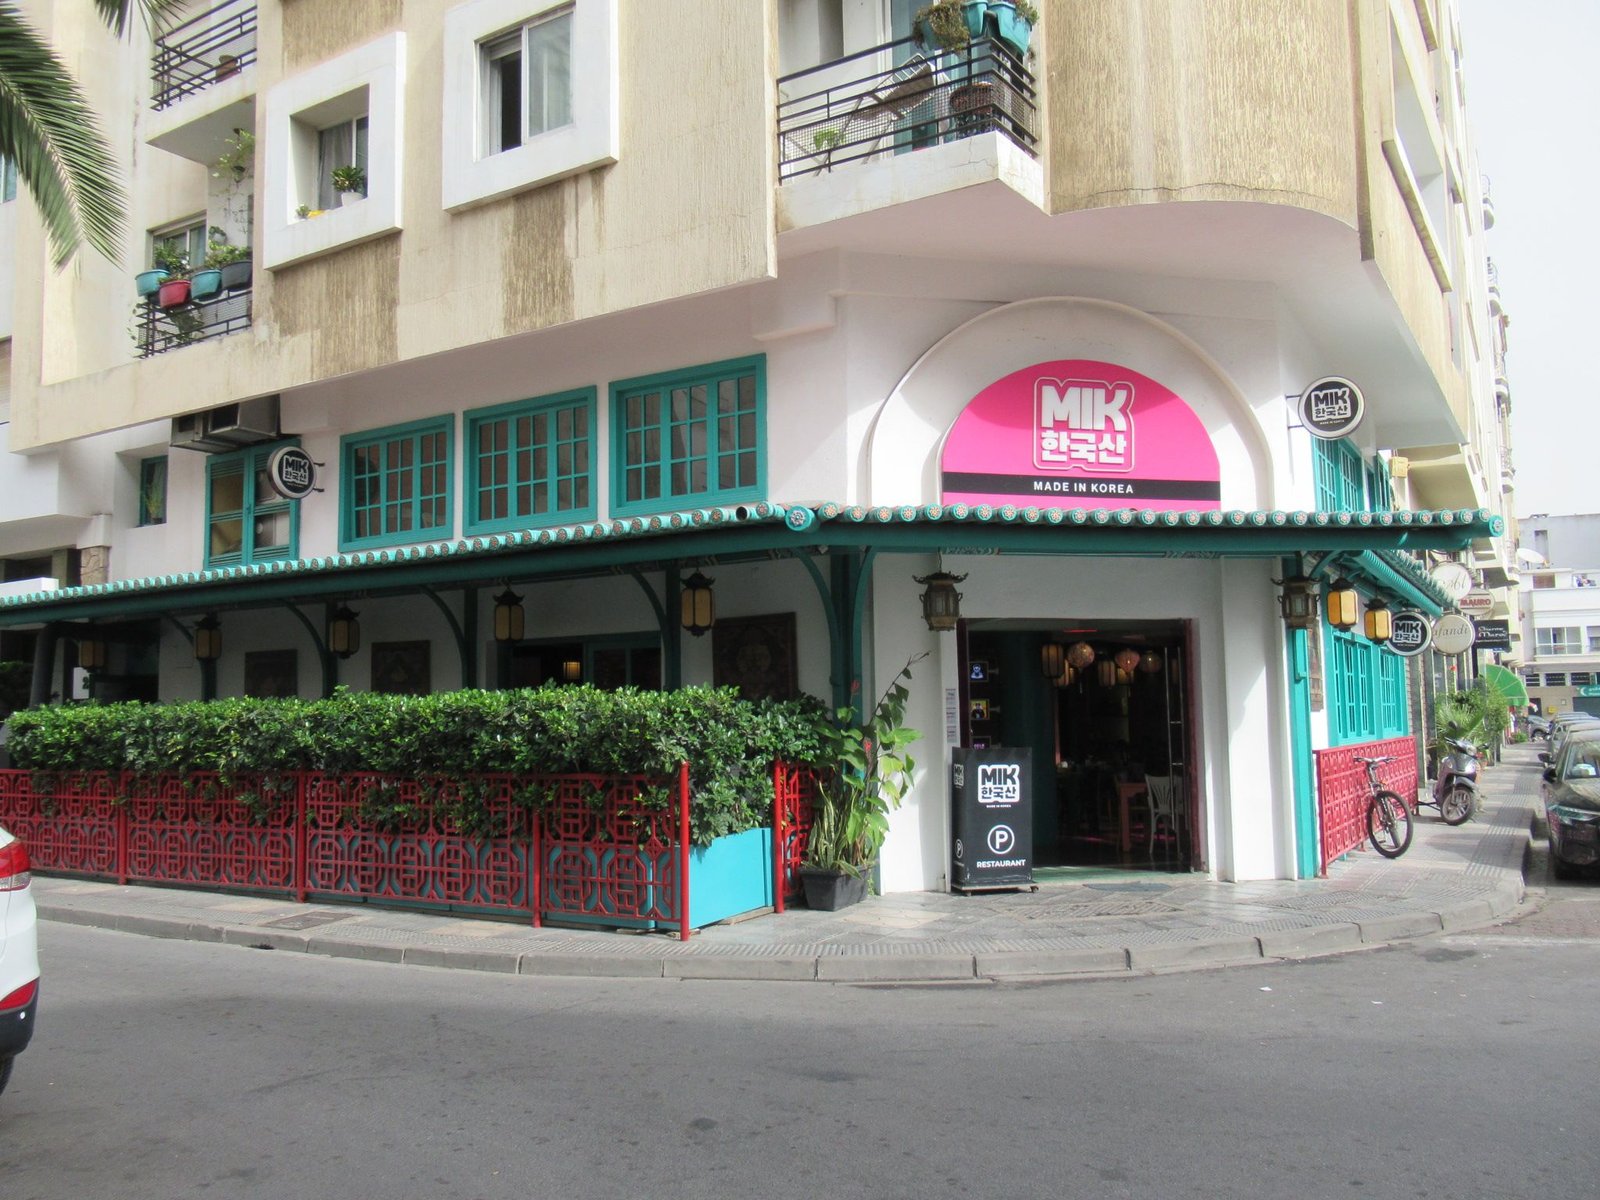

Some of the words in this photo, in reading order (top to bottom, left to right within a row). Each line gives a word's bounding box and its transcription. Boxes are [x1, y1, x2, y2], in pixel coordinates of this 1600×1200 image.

[1313, 390, 1348, 407] MIK
[1041, 385, 1128, 432] MIK
[1314, 405, 1348, 418] 한국산
[1041, 430, 1127, 465] 한국산
[285, 457, 308, 473] MIK
[1033, 481, 1069, 493] MADE
[1073, 482, 1087, 493] IN
[1090, 483, 1134, 494] KOREA
[1460, 597, 1491, 607] MAURO
[1394, 622, 1420, 633] MIK
[981, 767, 1017, 785] MIK
[981, 786, 1017, 799] 한국산
[995, 831, 1008, 850] P
[976, 859, 1026, 868] RESTAURANT
